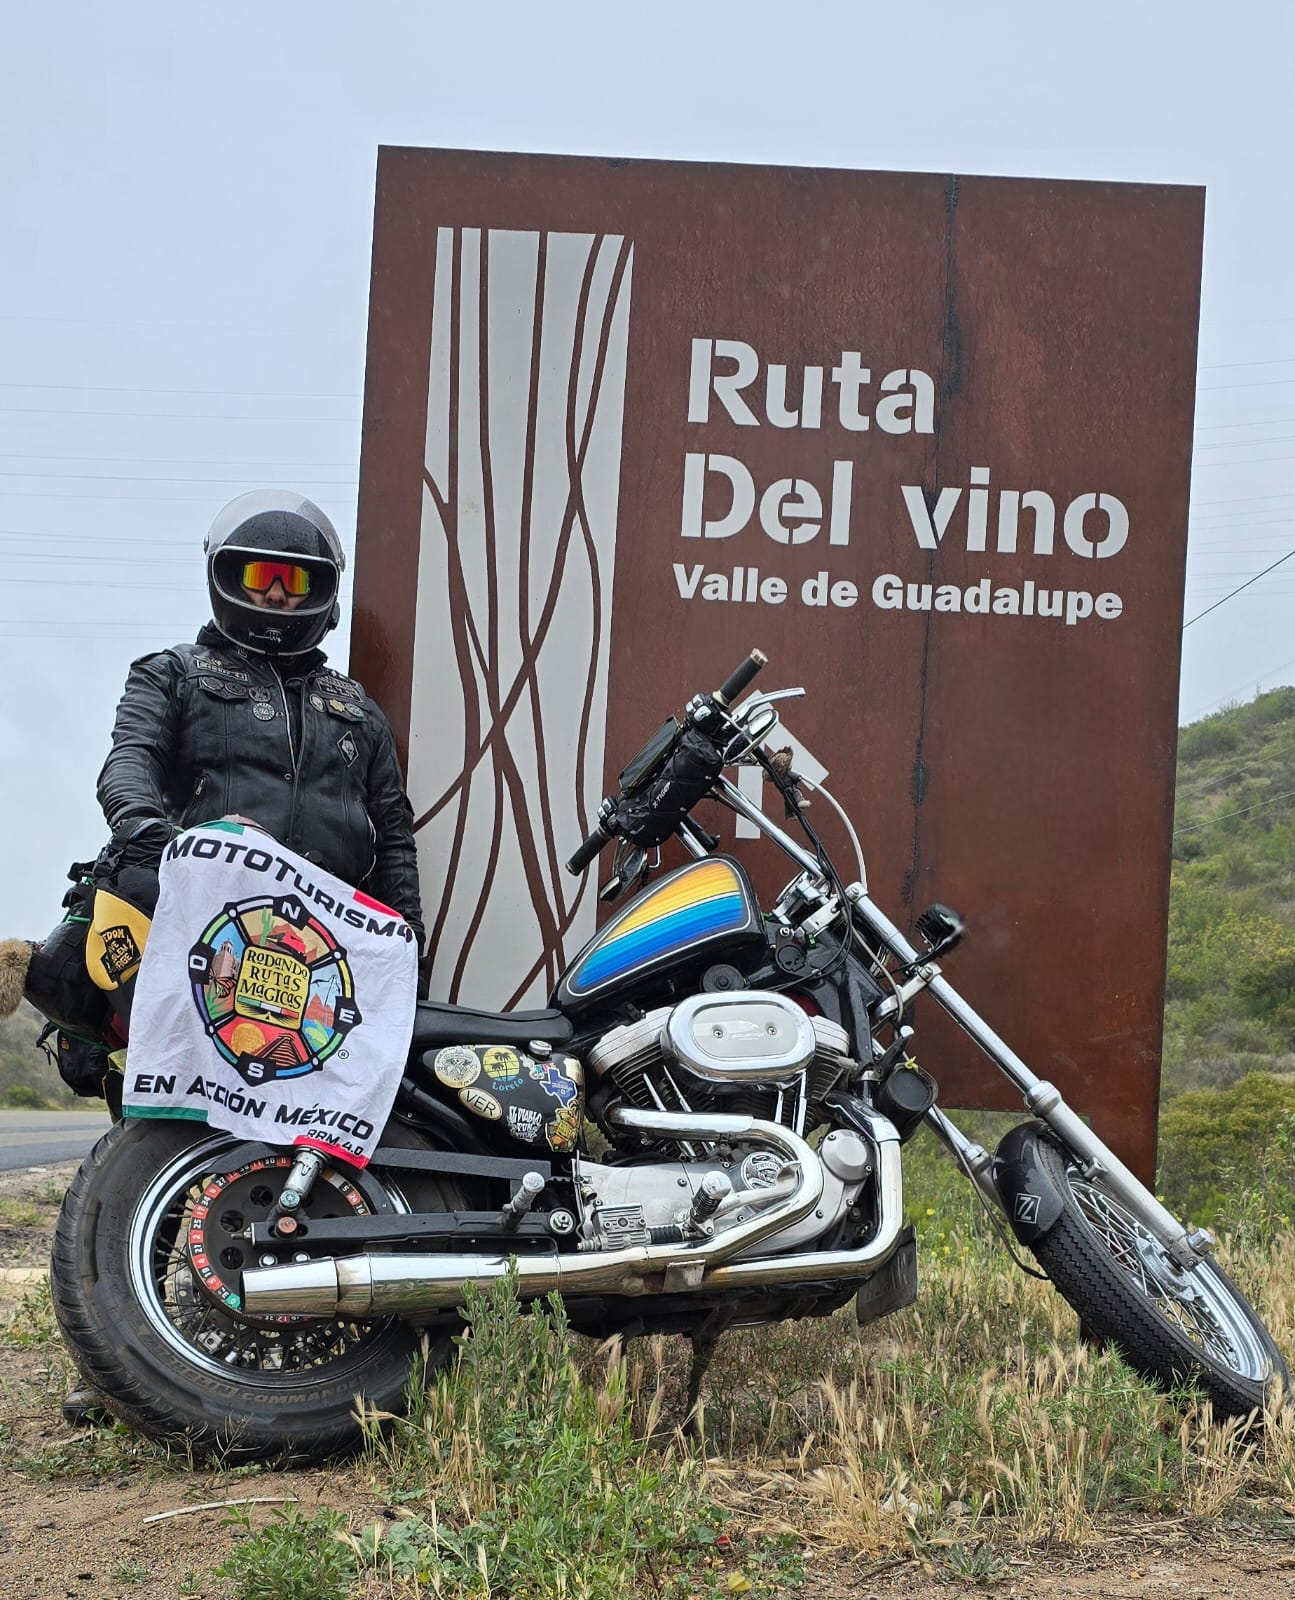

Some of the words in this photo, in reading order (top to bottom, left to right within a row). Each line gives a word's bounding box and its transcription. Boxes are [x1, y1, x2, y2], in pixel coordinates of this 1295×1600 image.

[687, 337, 936, 435] Ruta
[680, 452, 854, 546] Del
[900, 466, 1130, 560] vino
[672, 562, 788, 605] Valle
[801, 571, 858, 607] de
[871, 573, 1124, 626] Guadalupe
[165, 835, 413, 943] MOTOTURISMO
[281, 901, 301, 920] N
[339, 1008, 356, 1024] E
[247, 1062, 265, 1078] S
[133, 1074, 177, 1095] EN
[274, 1103, 375, 1140] MÉXICO
[466, 1090, 497, 1117] VER
[342, 1141, 364, 1156] 4.0
[193, 1218, 202, 1229] 25
[193, 1244, 203, 1253] 21
